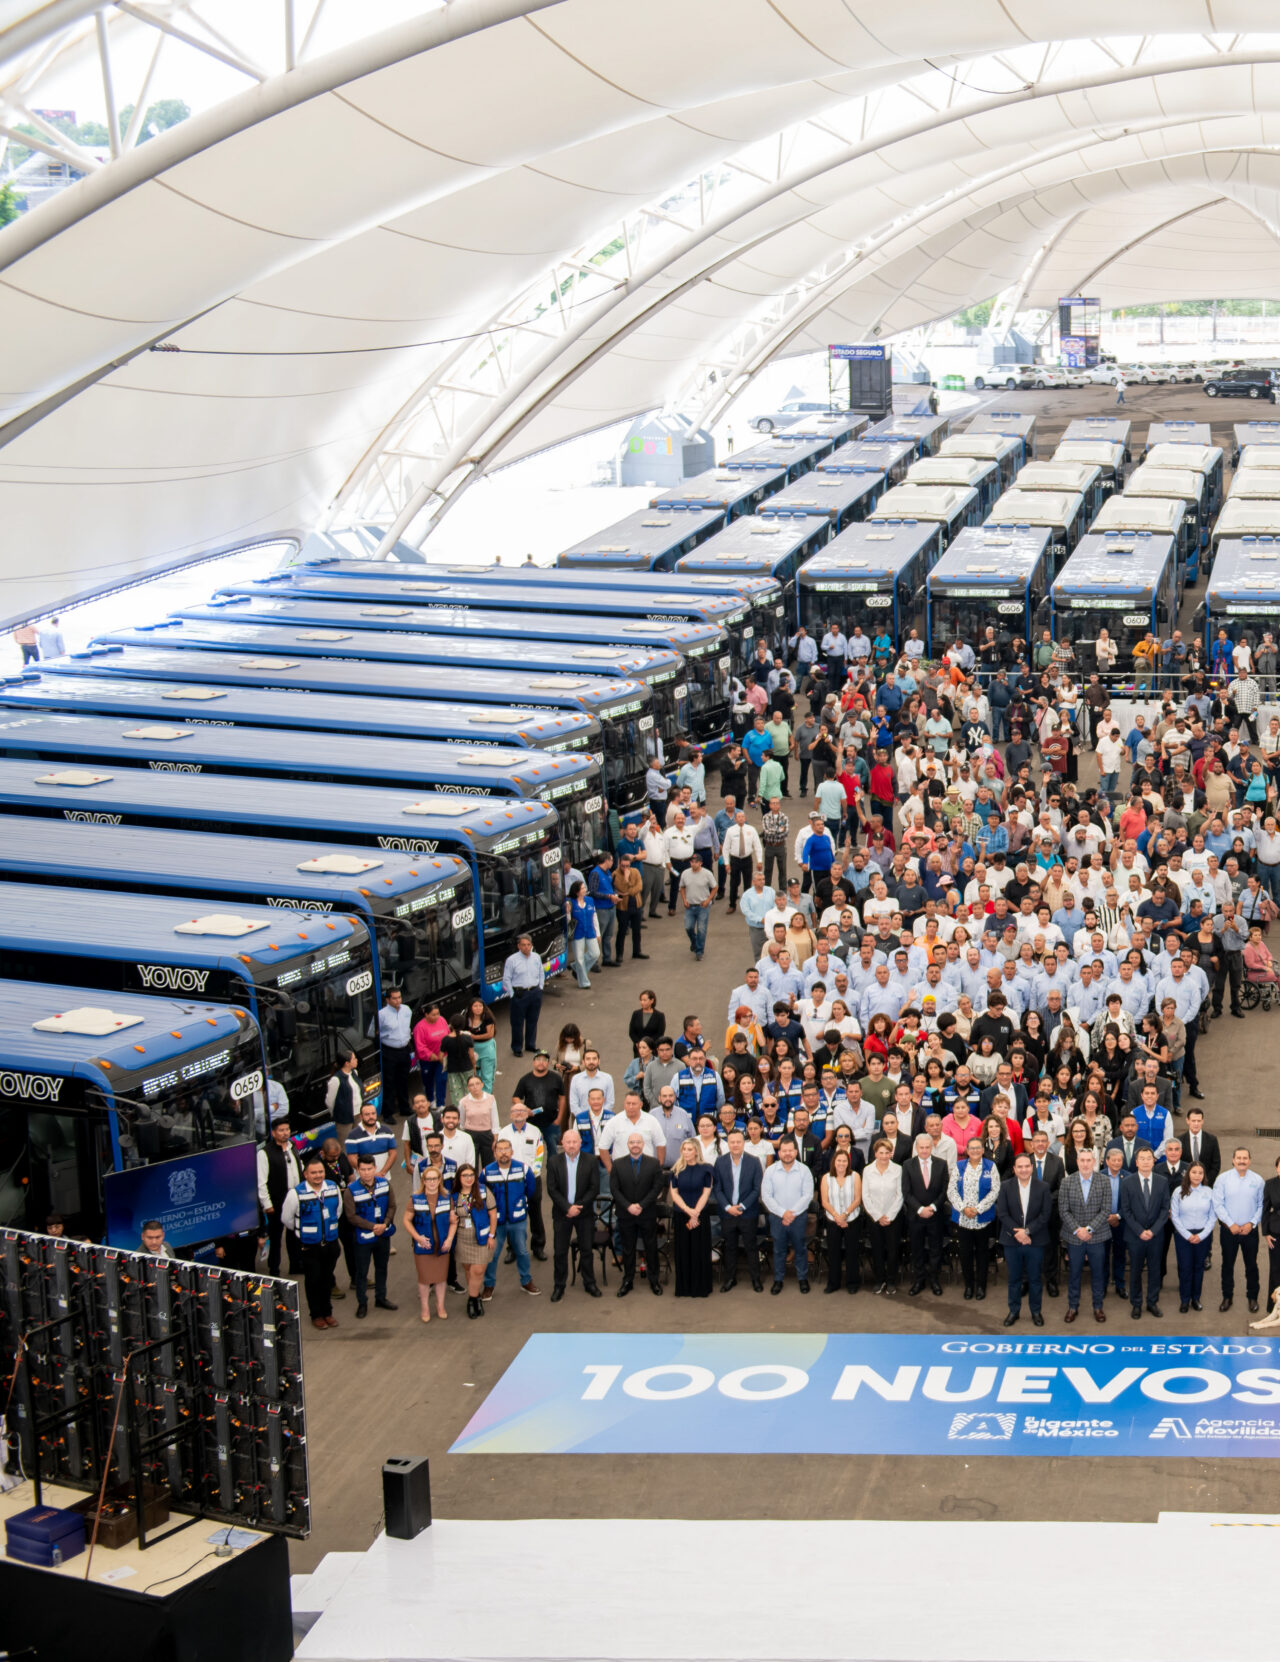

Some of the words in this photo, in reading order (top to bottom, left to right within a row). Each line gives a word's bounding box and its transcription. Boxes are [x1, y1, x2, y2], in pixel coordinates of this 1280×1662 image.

[868, 598, 889, 606] 0625
[1000, 605, 1021, 613] 0606
[1125, 616, 1146, 624] 0607
[544, 847, 561, 865] 0624
[455, 908, 473, 926] 0665
[137, 964, 210, 992] YOVOY
[349, 974, 371, 993] 0633
[234, 1073, 260, 1097] 0659
[194, 1201, 226, 1215] ESTADO
[941, 1341, 1115, 1355] GOBIERNO
[1150, 1343, 1271, 1356] ESTADO
[581, 1364, 810, 1401] 100
[1196, 1418, 1275, 1427] Agencia
[1037, 1427, 1119, 1437] México
